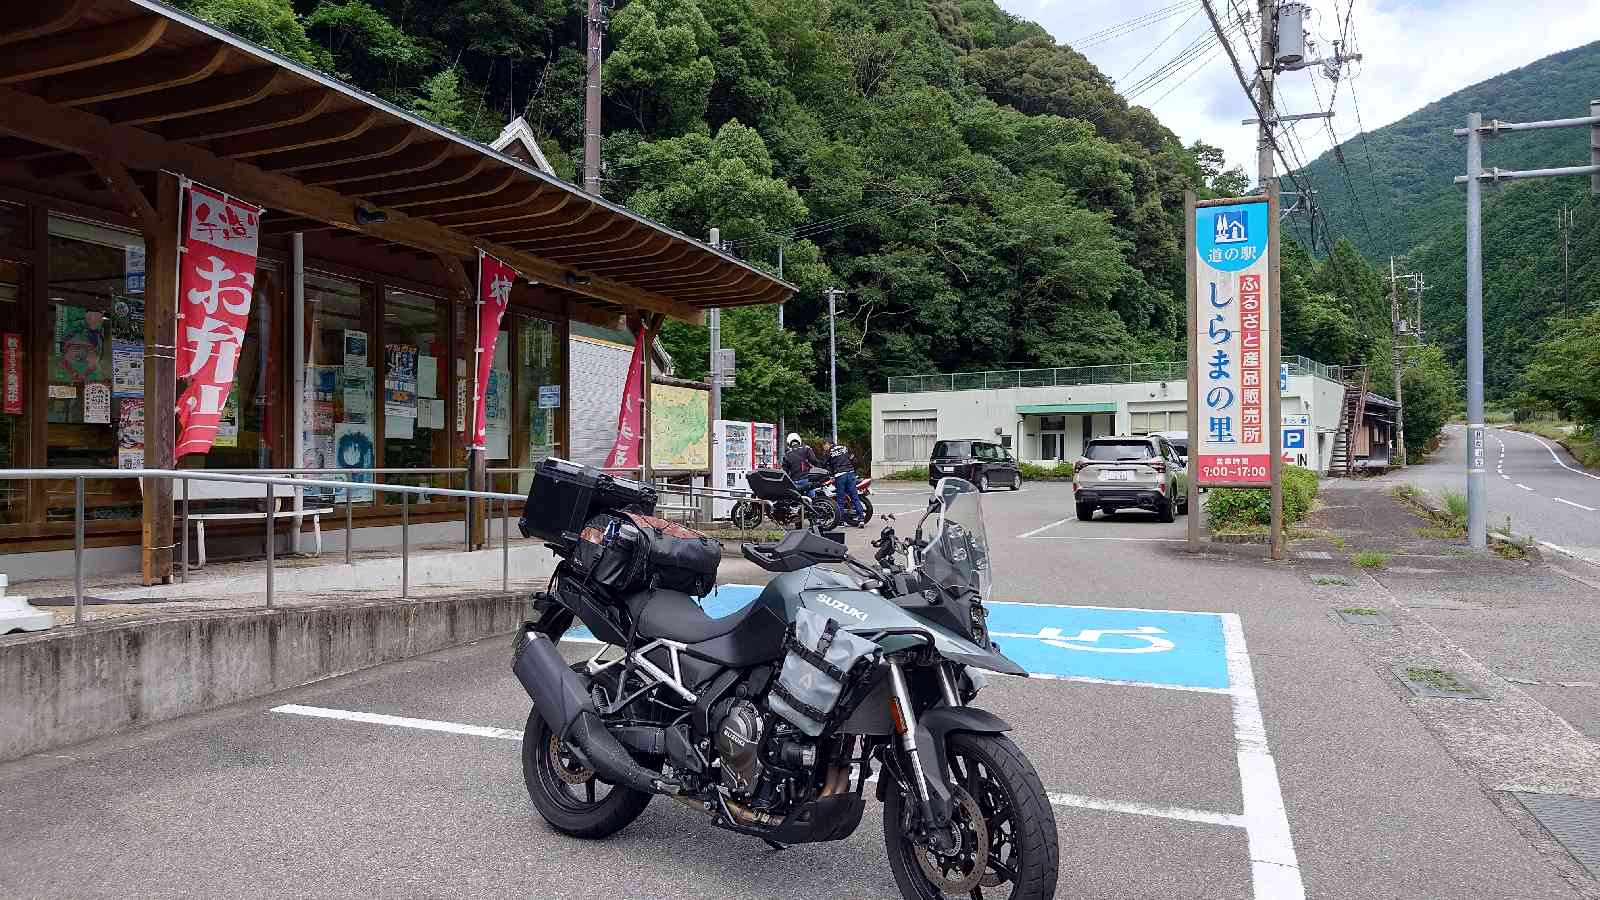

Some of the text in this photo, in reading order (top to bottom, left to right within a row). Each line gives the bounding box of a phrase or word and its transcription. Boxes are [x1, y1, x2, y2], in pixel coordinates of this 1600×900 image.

[1207, 246, 1257, 263] 道の駅
[1205, 281, 1238, 443] しらまの里
[1241, 277, 1261, 443] ふるさと産品販売所
[1287, 433, 1301, 447] P
[1297, 453, 1308, 467] IN
[815, 593, 869, 622] SUZUKI
[723, 729, 746, 747] SUZUKI
